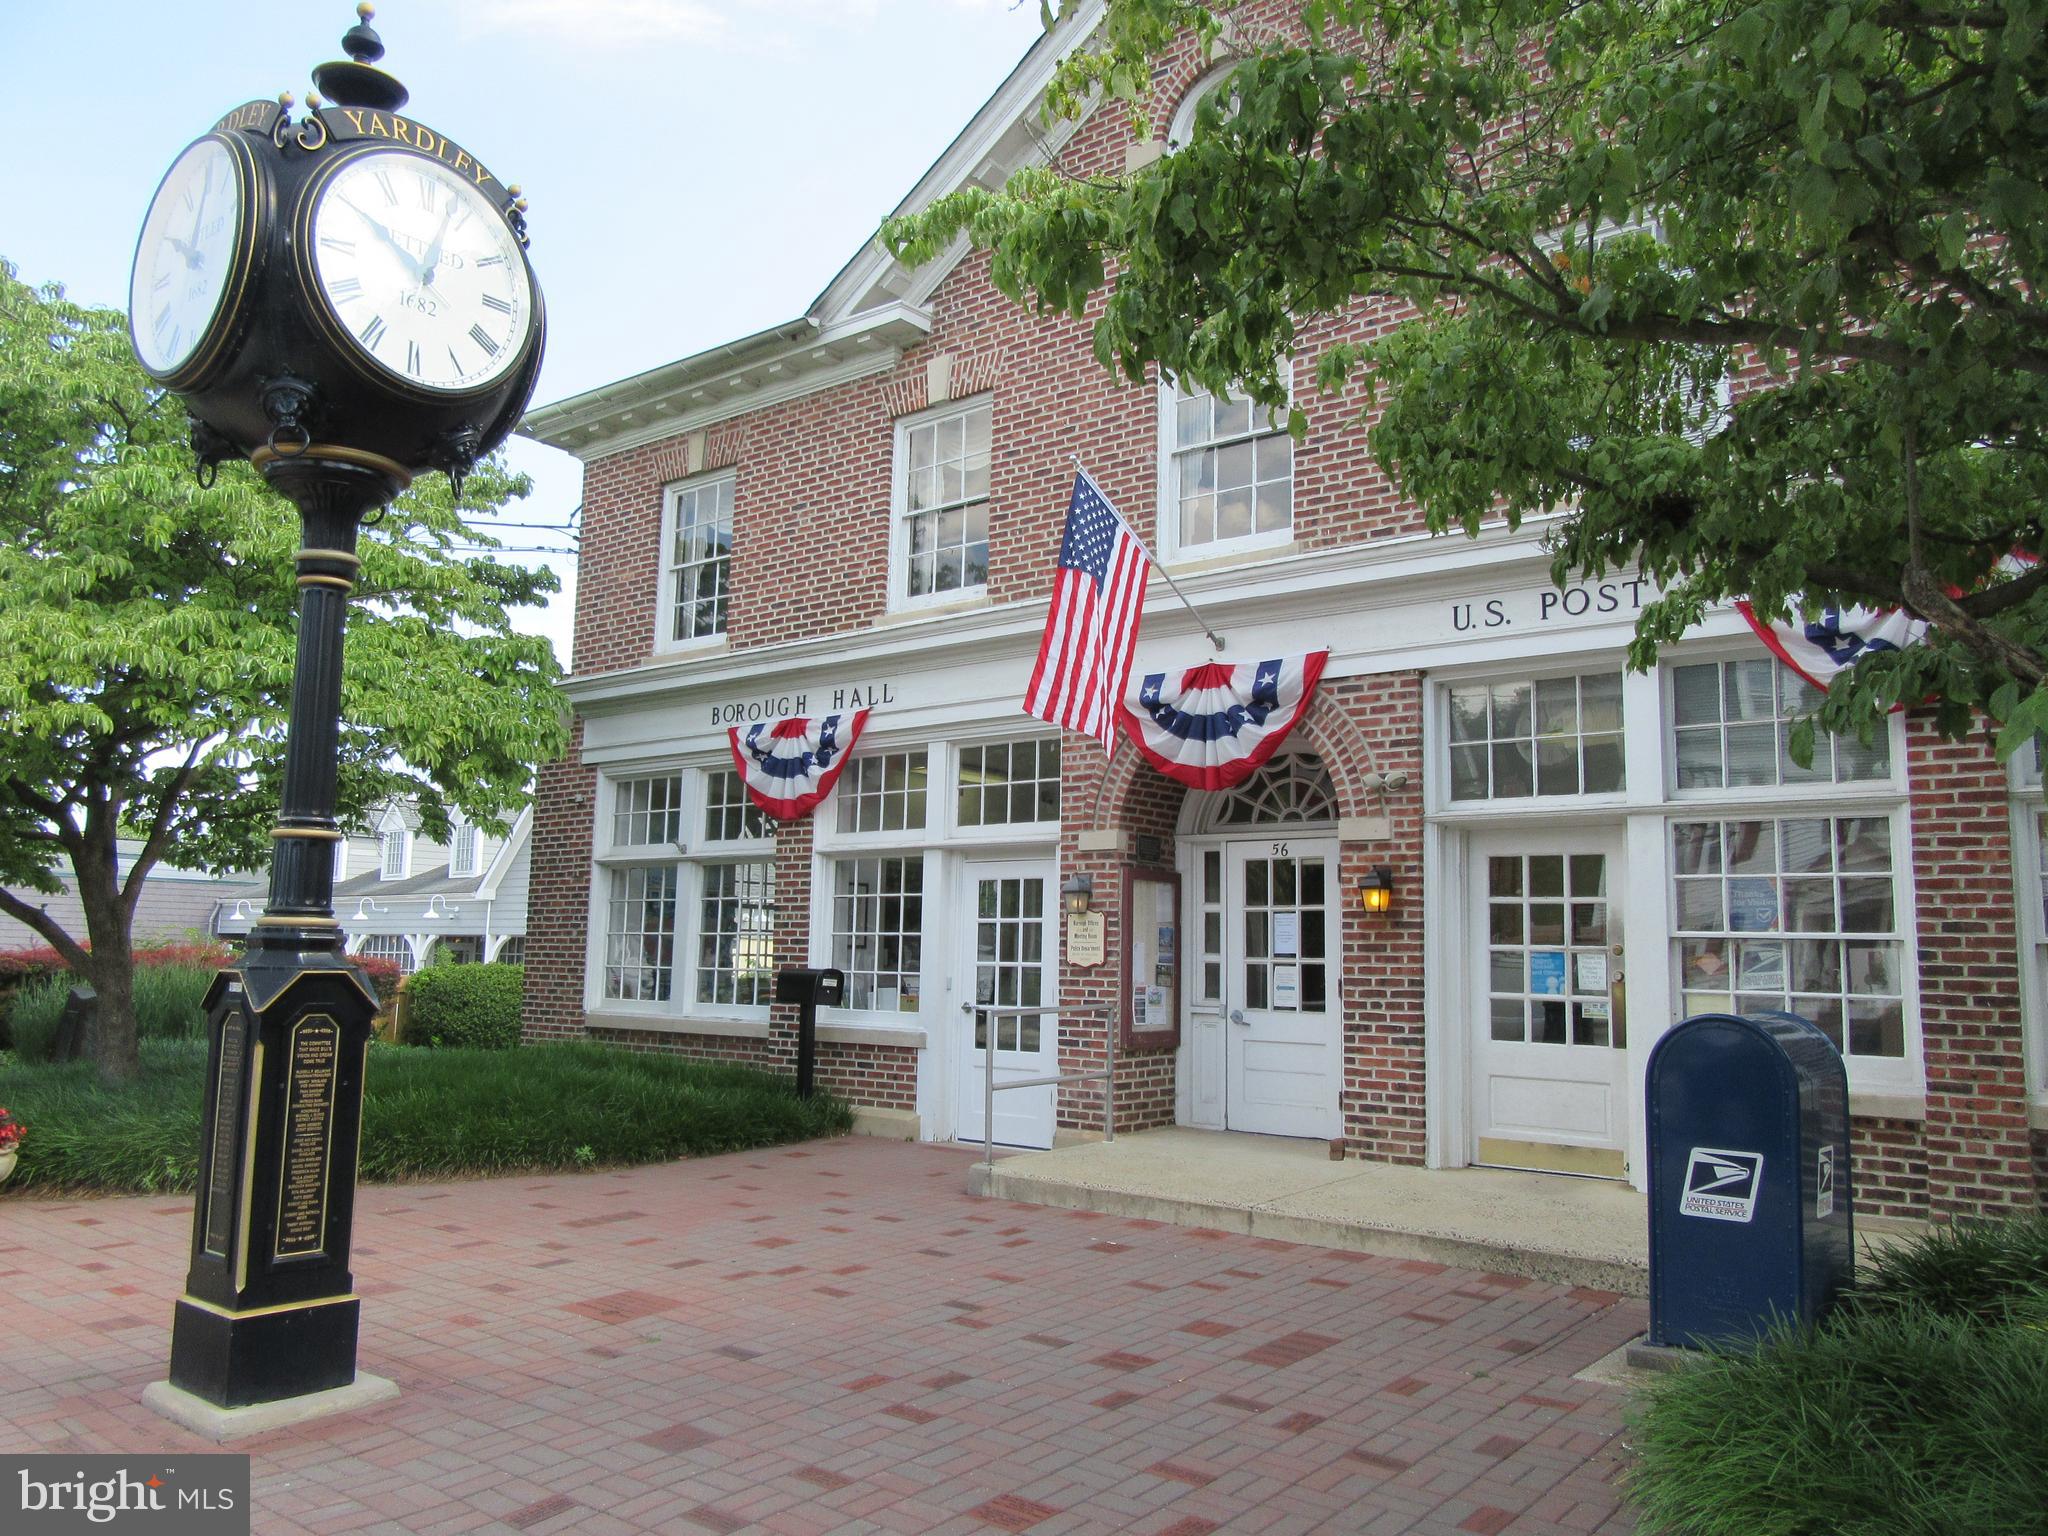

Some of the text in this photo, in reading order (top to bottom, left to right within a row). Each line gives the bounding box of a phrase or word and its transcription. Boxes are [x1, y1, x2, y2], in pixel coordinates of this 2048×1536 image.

[343, 110, 493, 187] YARDLEY
[399, 290, 438, 318] 1682
[1452, 578, 1649, 631] U.S. POST
[711, 683, 895, 726] BOROUGH HALL
[1270, 842, 1290, 857] 56
[1684, 1203, 1748, 1218] POSTAL SERVICE
[1686, 1196, 1745, 1209] UNITED STATES
